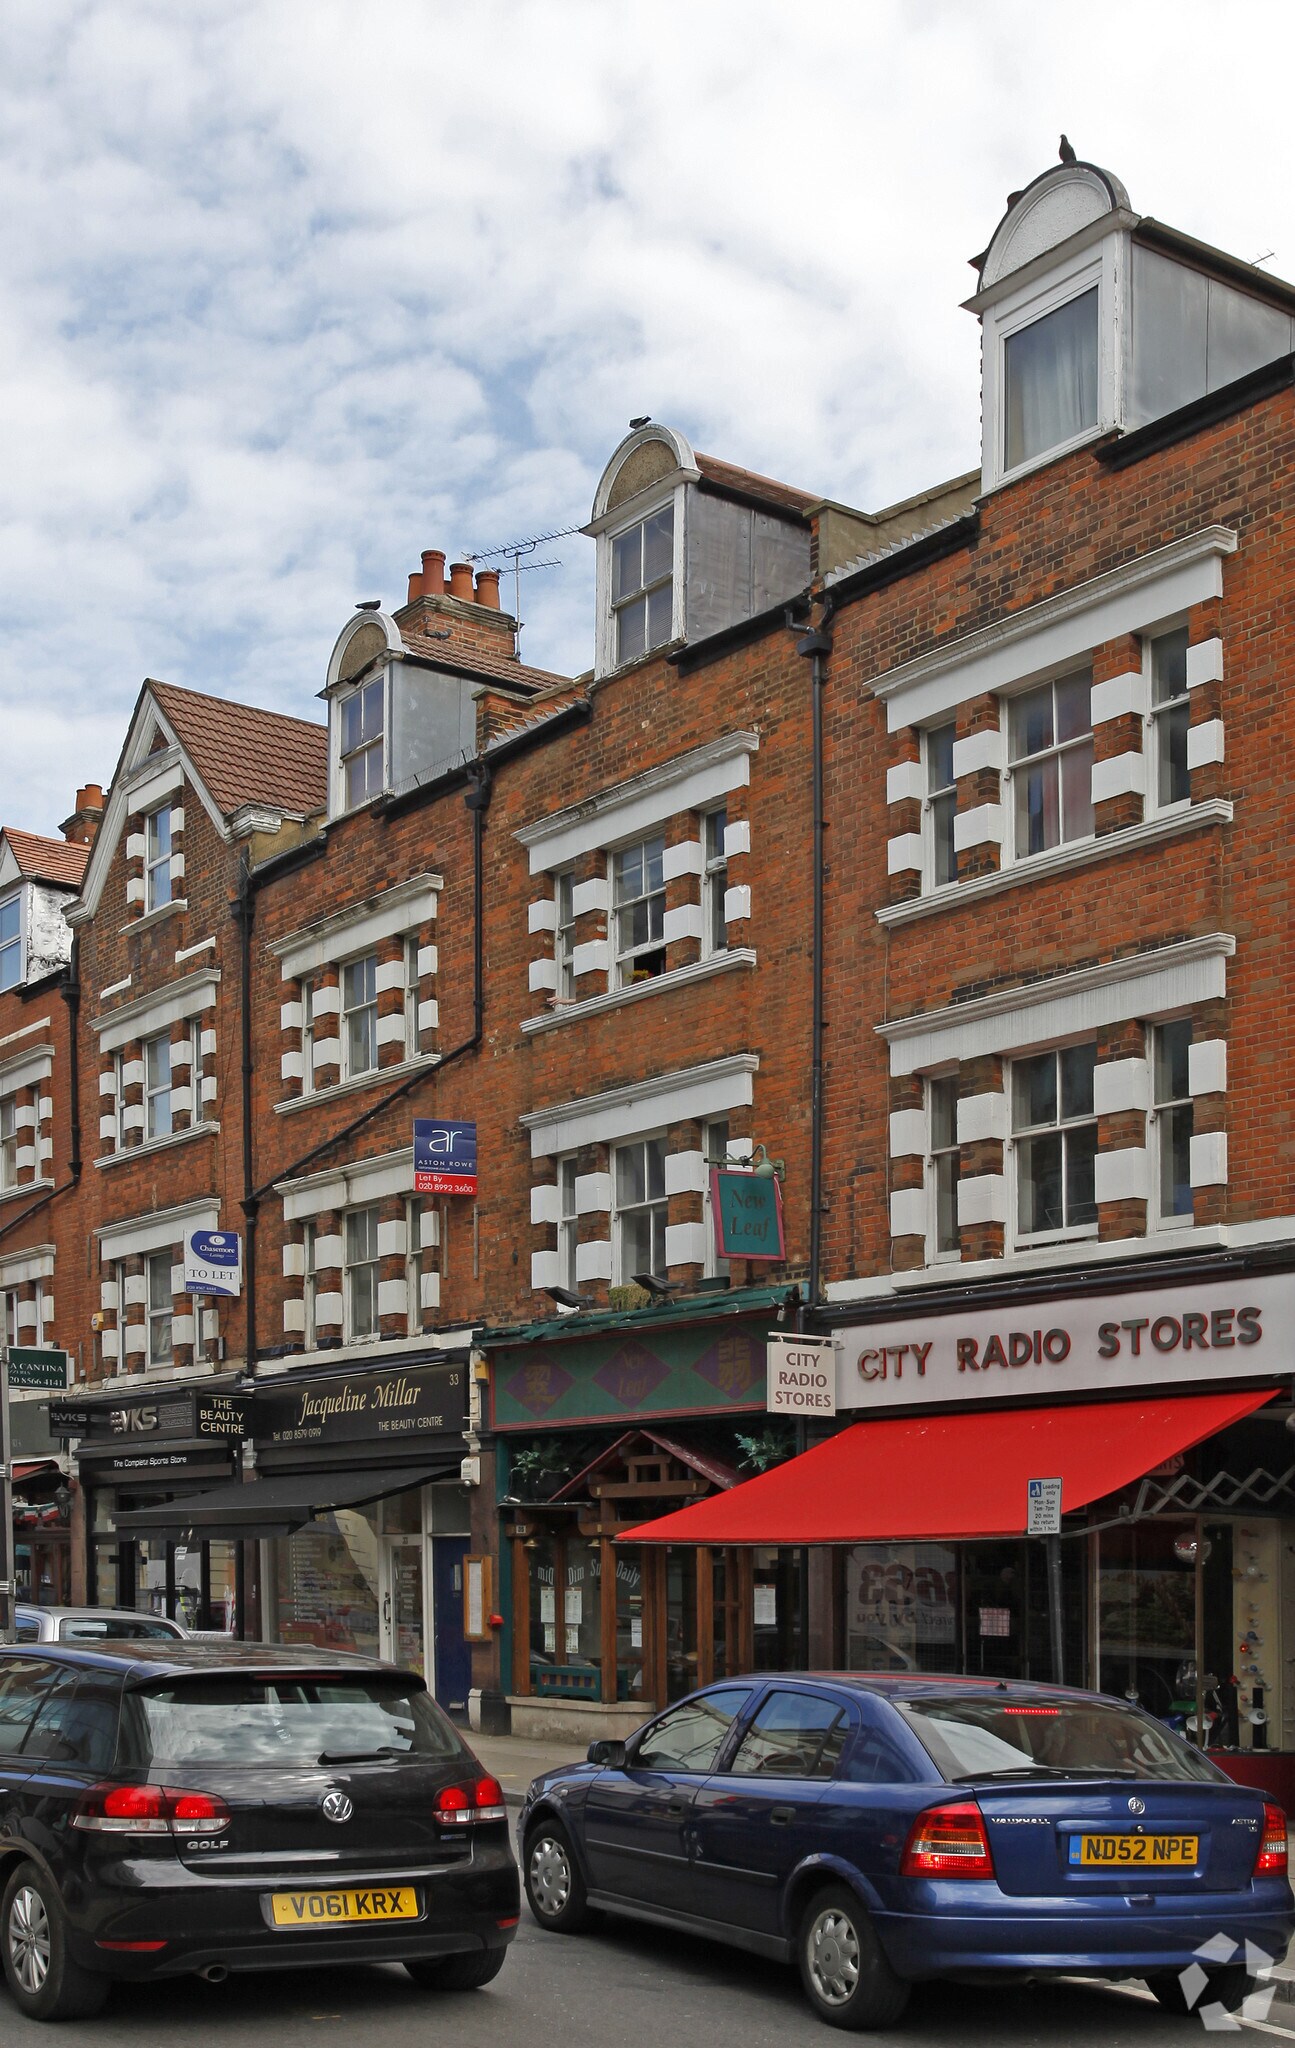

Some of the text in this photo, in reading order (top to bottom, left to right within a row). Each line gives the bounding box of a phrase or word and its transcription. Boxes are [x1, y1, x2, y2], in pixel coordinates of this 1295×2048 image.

[433, 1175, 442, 1183] By
[418, 1182, 474, 1193] 020 8992 3600
[730, 1188, 766, 1210] New
[731, 1215, 770, 1241] Leaf
[200, 1244, 235, 1253] Chasemore
[189, 1269, 235, 1280] TO LET
[856, 1306, 1262, 1381] CITY RADIO STORES
[786, 1352, 820, 1367] CITY
[20, 1362, 64, 1372] CANTINA
[449, 1374, 459, 1386] 33
[779, 1371, 827, 1388] RADIO
[212, 1399, 233, 1410] THE
[298, 1377, 421, 1426] Jacqueline Millar
[775, 1391, 831, 1408] STORES
[60, 1412, 87, 1422] VKS
[120, 1406, 159, 1433] VKS
[200, 1409, 244, 1422] BEAUTY
[200, 1422, 245, 1434] CENTRE
[378, 1415, 443, 1431] THE BEAUTY CENTRE
[282, 1430, 293, 1441] 020
[294, 1429, 307, 1439] 8579
[308, 1427, 321, 1438] 0919
[114, 1459, 124, 1467] The
[149, 1457, 169, 1466] Sports
[170, 1456, 187, 1464] Store
[568, 1559, 641, 1588] Dim Su Daily
[187, 1840, 229, 1850] GOLF
[1086, 1838, 1194, 1860] ND52 NPE
[290, 1891, 404, 1919] VO61 KRX
